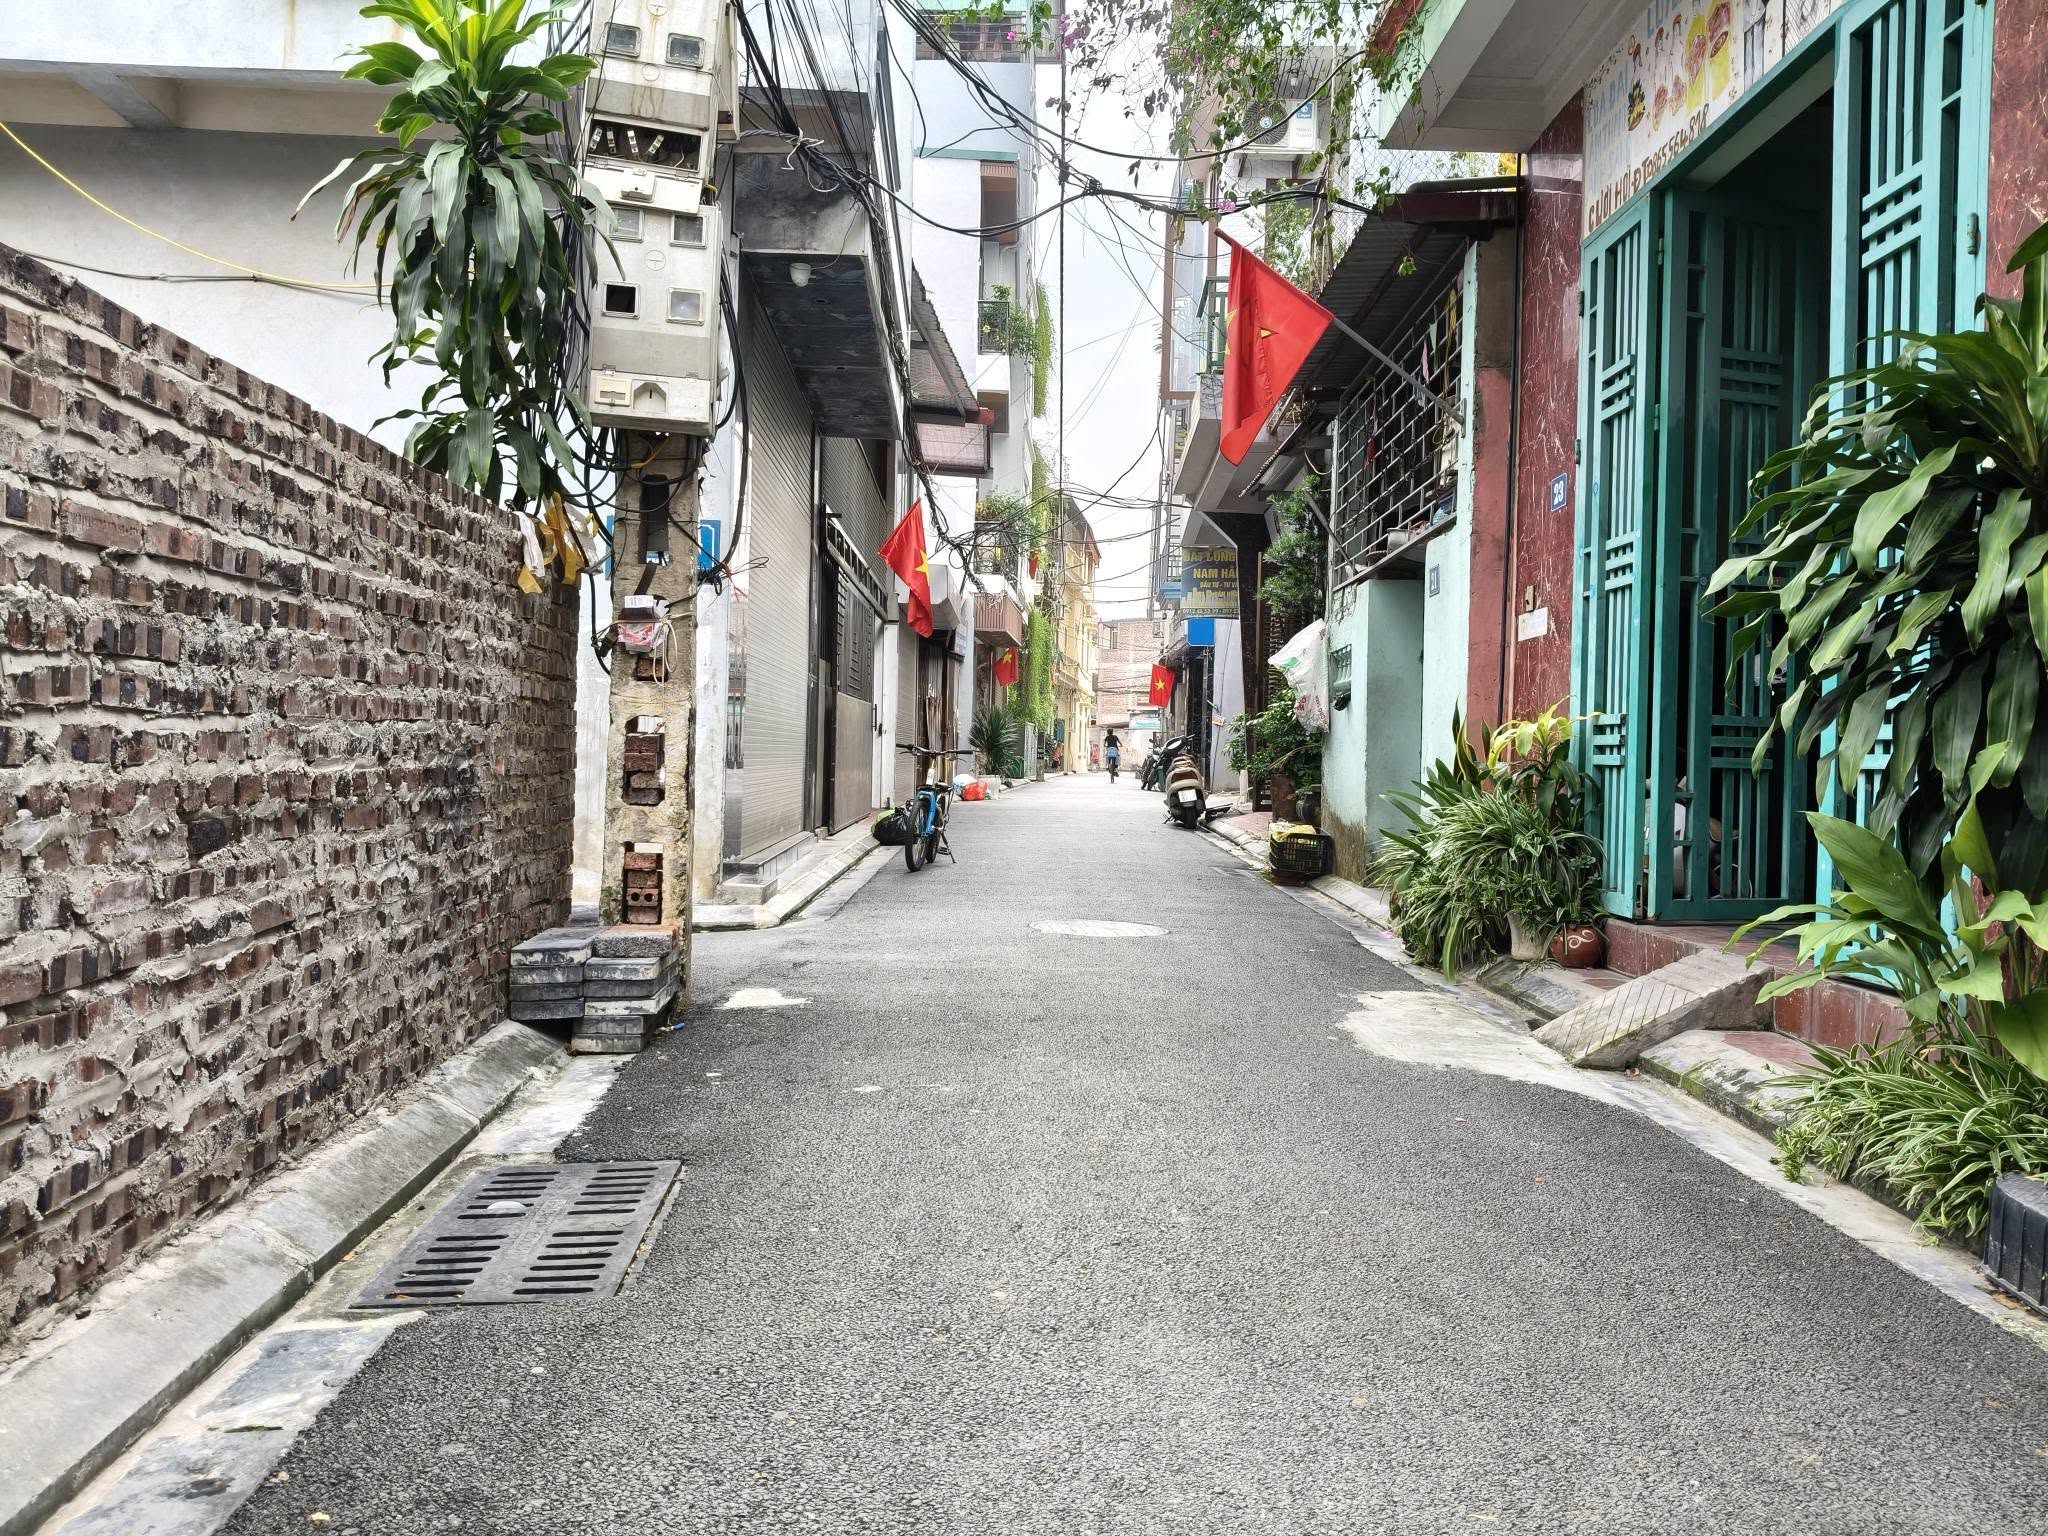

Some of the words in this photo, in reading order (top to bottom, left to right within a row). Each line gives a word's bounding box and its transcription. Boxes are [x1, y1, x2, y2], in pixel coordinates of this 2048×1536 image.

[1553, 480, 1564, 506] 23
[1193, 568, 1218, 579] NAM
[1221, 564, 1237, 579] HẢ
